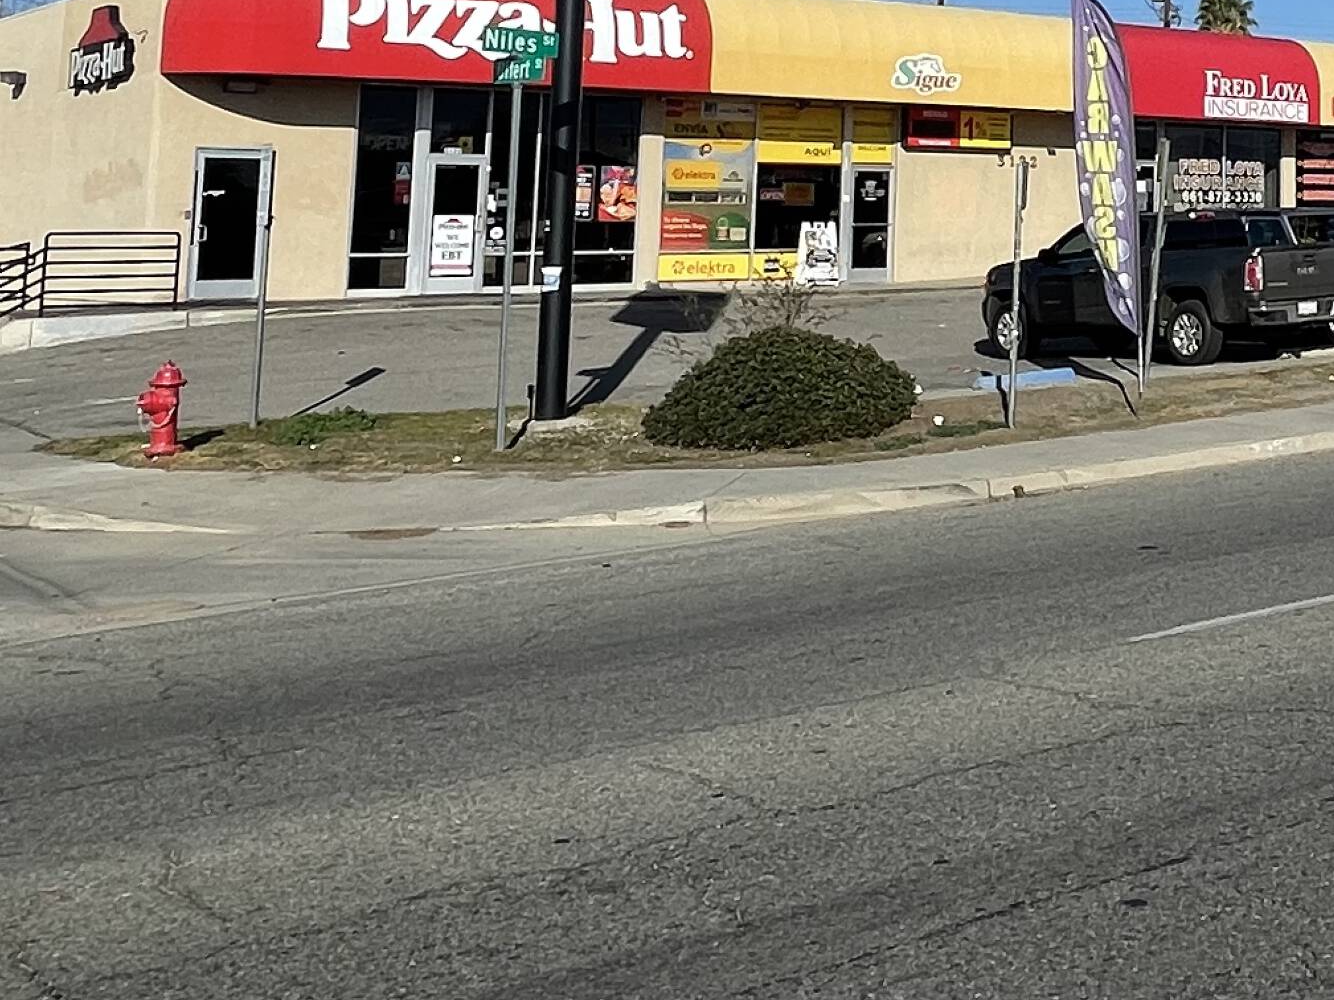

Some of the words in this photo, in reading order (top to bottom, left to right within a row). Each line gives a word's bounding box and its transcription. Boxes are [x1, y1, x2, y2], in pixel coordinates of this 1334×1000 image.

[485, 28, 537, 53] Niles
[543, 34, 555, 47] St
[69, 47, 101, 87] Pizza
[101, 41, 126, 80] Hut
[894, 58, 957, 92] Sigue
[1204, 69, 1257, 98] FRED
[1260, 74, 1309, 102] LOYA
[1207, 99, 1305, 120] INSURANCE
[1178, 158, 1221, 175] FRED
[1226, 160, 1263, 176] LOYA
[687, 260, 736, 275] elektra
